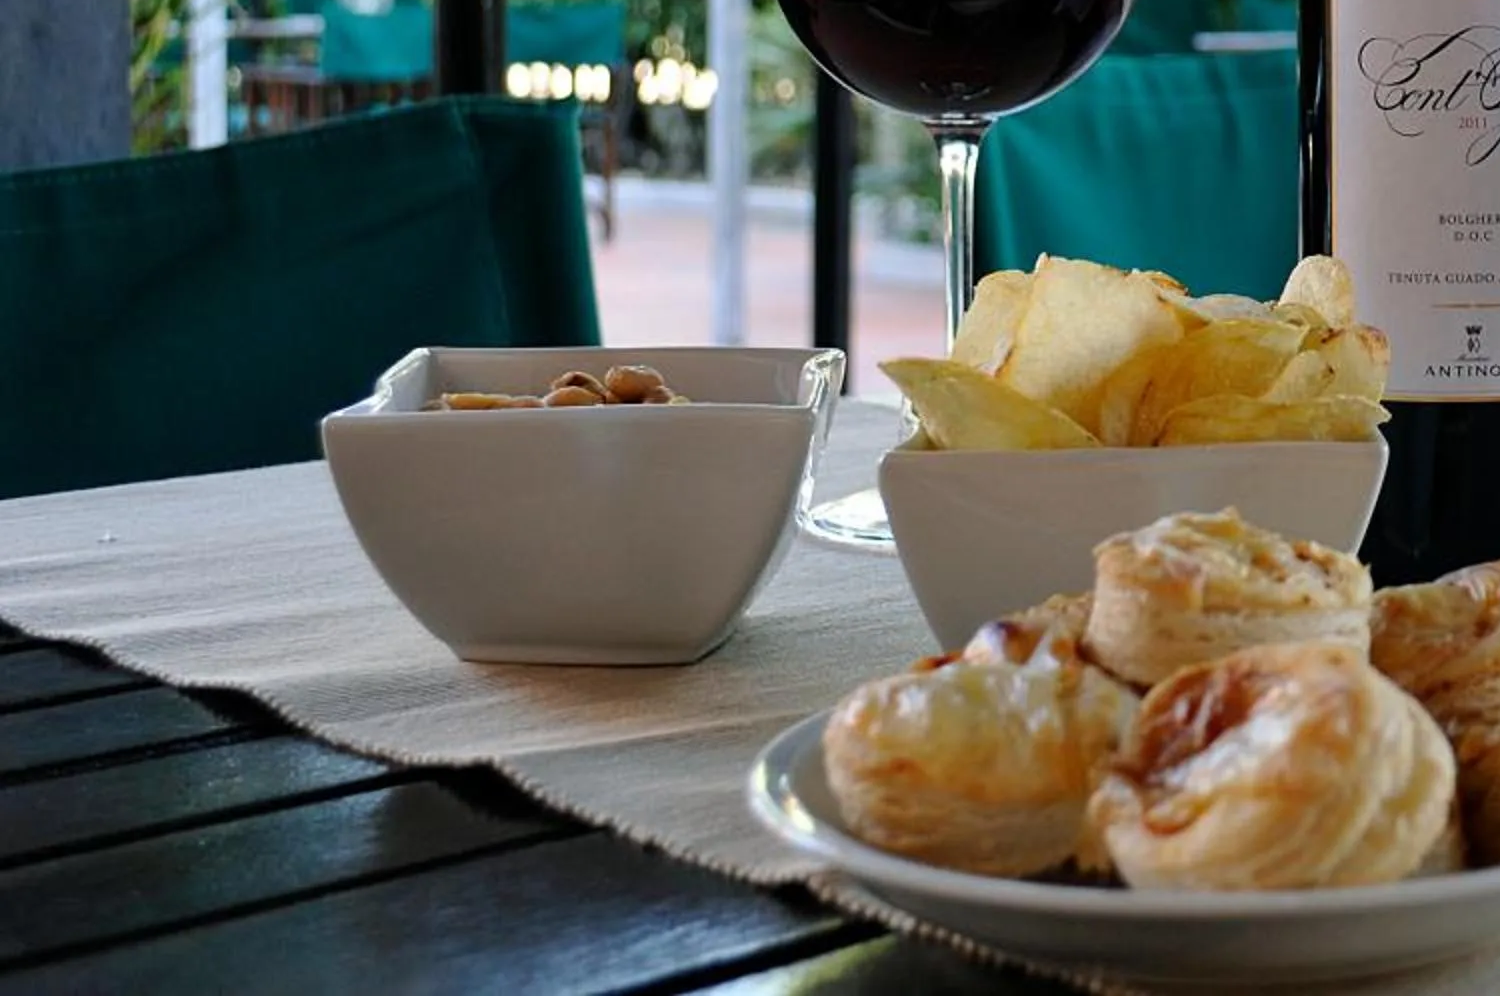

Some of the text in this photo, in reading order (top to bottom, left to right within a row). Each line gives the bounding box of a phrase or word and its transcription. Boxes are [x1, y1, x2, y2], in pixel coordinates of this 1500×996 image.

[1458, 116, 1488, 129] 2011
[1387, 271, 1441, 285] TENUTA
[1445, 271, 1496, 285] GUADO
